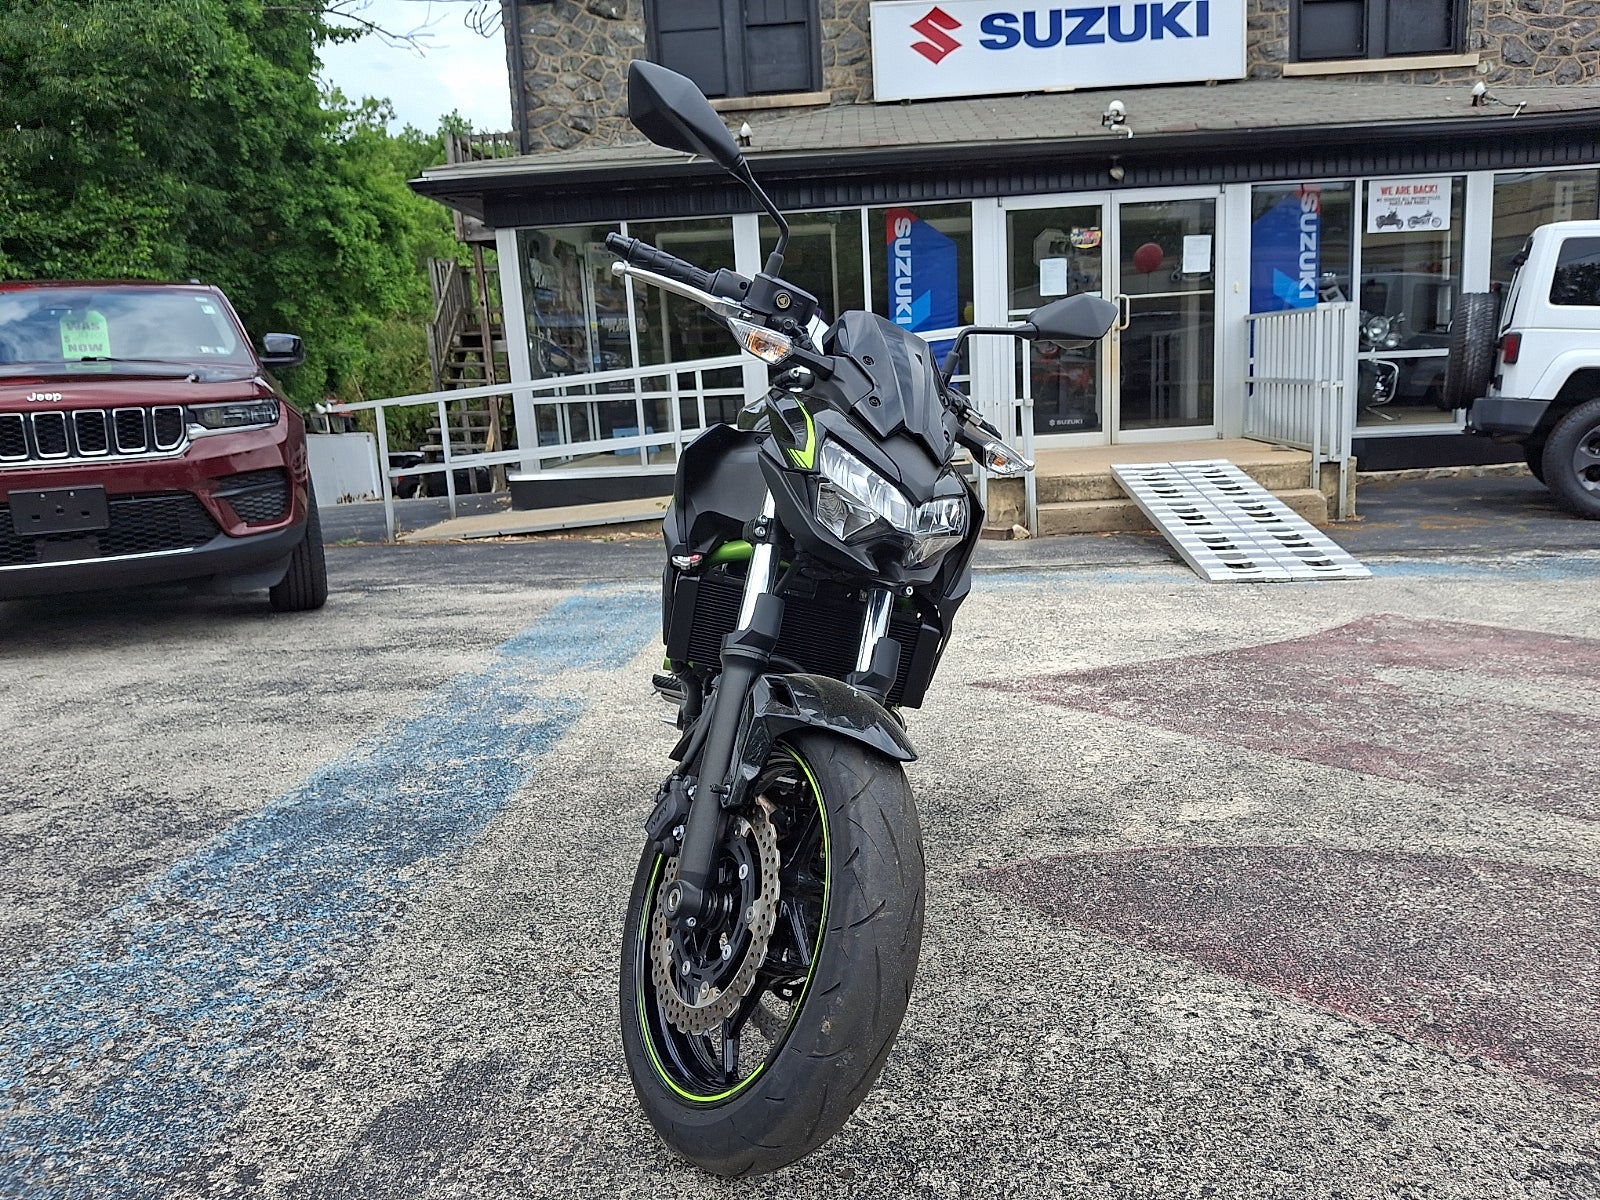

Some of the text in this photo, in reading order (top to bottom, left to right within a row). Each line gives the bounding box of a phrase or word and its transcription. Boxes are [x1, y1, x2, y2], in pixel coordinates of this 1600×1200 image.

[979, 1, 1209, 50] SUZUKI
[1381, 184, 1438, 196] WE ARE BACK!
[1299, 192, 1318, 299] SUZUKI
[894, 217, 912, 325] SUZUKI
[66, 321, 100, 331] WAS
[67, 343, 103, 352] NOW
[26, 392, 62, 402] Jeep
